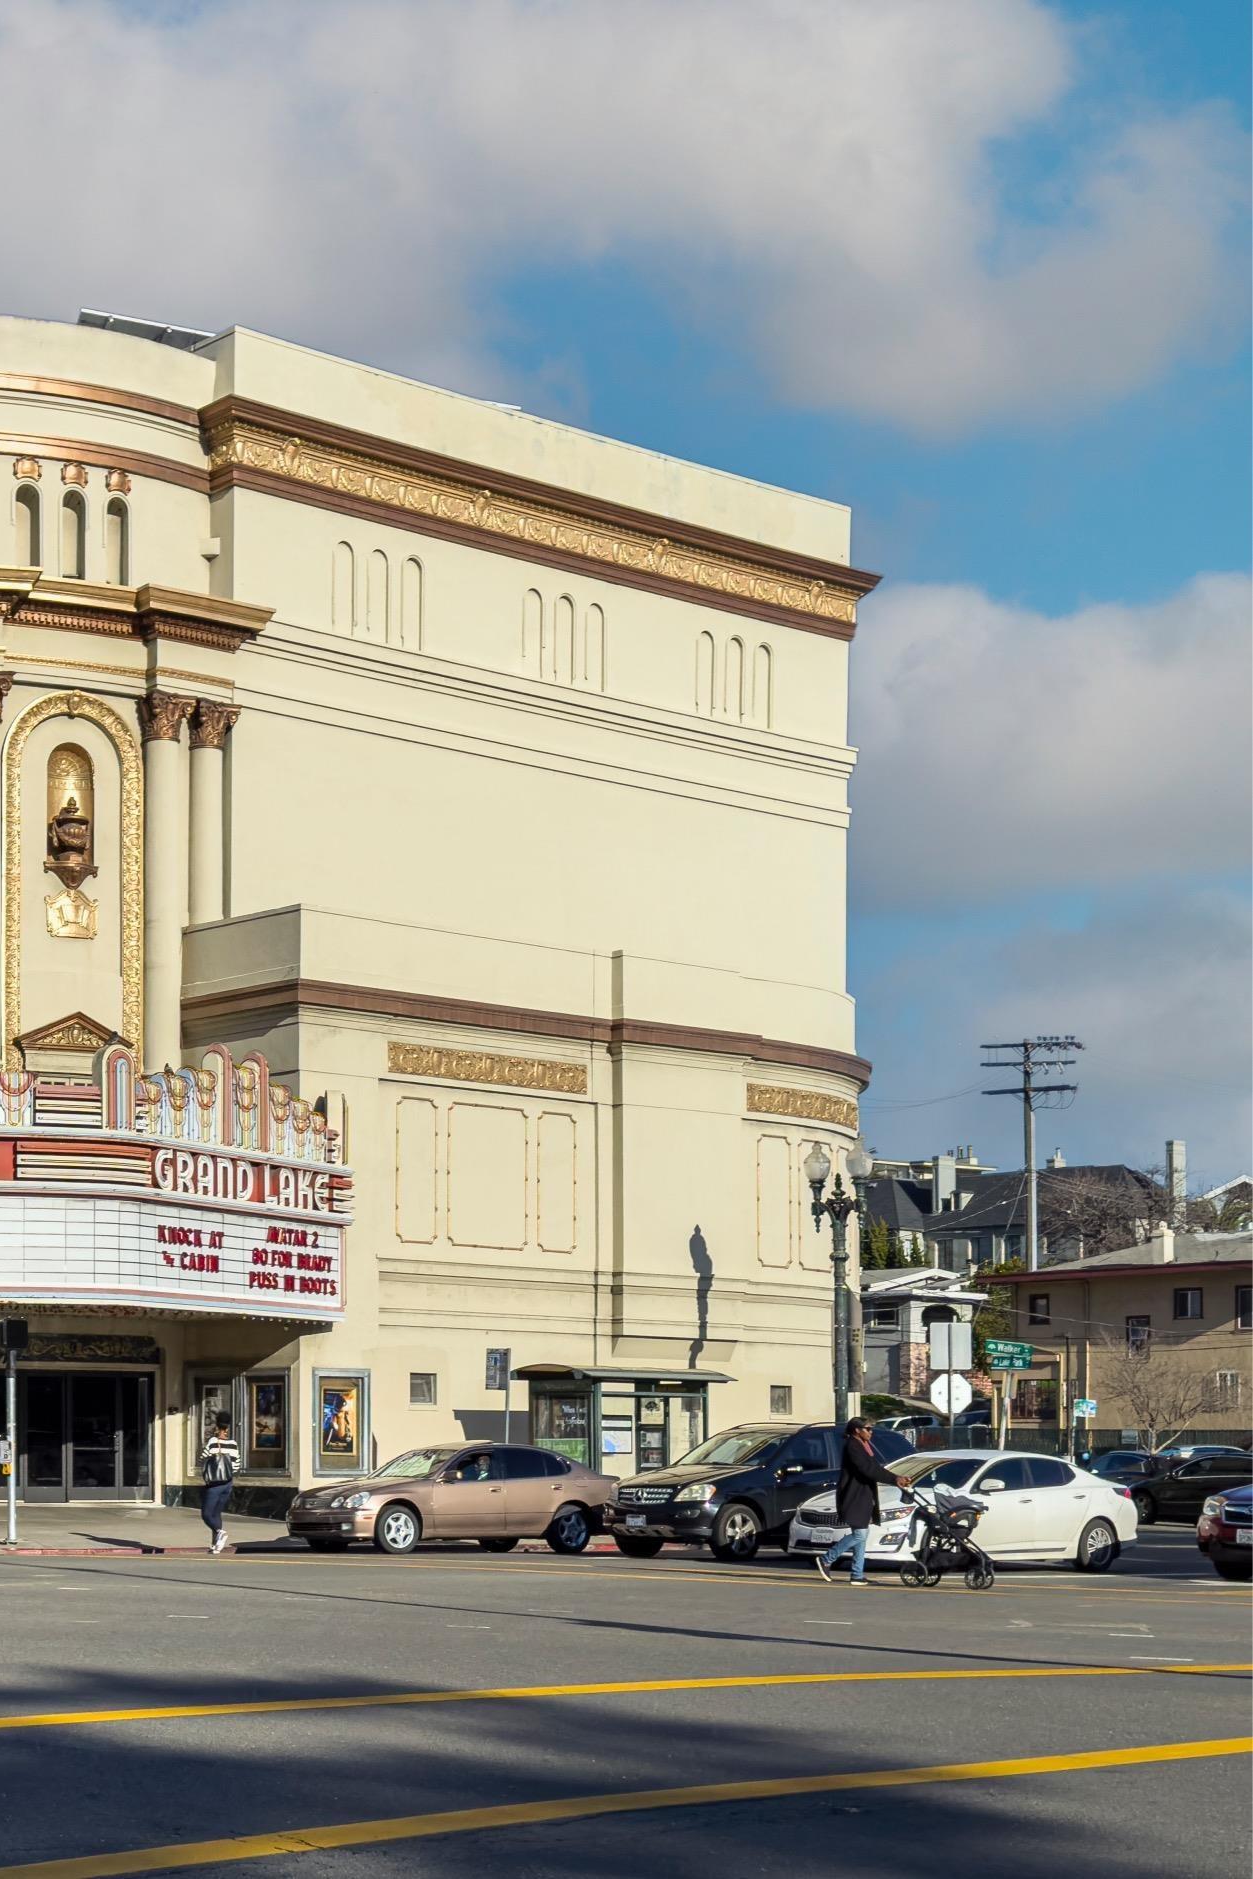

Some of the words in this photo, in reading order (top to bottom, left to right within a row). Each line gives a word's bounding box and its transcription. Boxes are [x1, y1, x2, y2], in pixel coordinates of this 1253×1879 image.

[154, 1148, 253, 1201] GRAND
[264, 1164, 330, 1212] LAKE
[158, 1224, 202, 1248] KNOCK
[208, 1230, 224, 1249] AT
[267, 1226, 308, 1248] AVATAR
[311, 1231, 319, 1248] 2
[180, 1252, 220, 1273] CABIN
[271, 1250, 292, 1268] FOR
[297, 1252, 333, 1273] BRADY
[249, 1271, 278, 1289] PUSS
[284, 1275, 295, 1292] IN
[300, 1276, 336, 1296] BOOTS
[998, 1343, 1021, 1353] Walker
